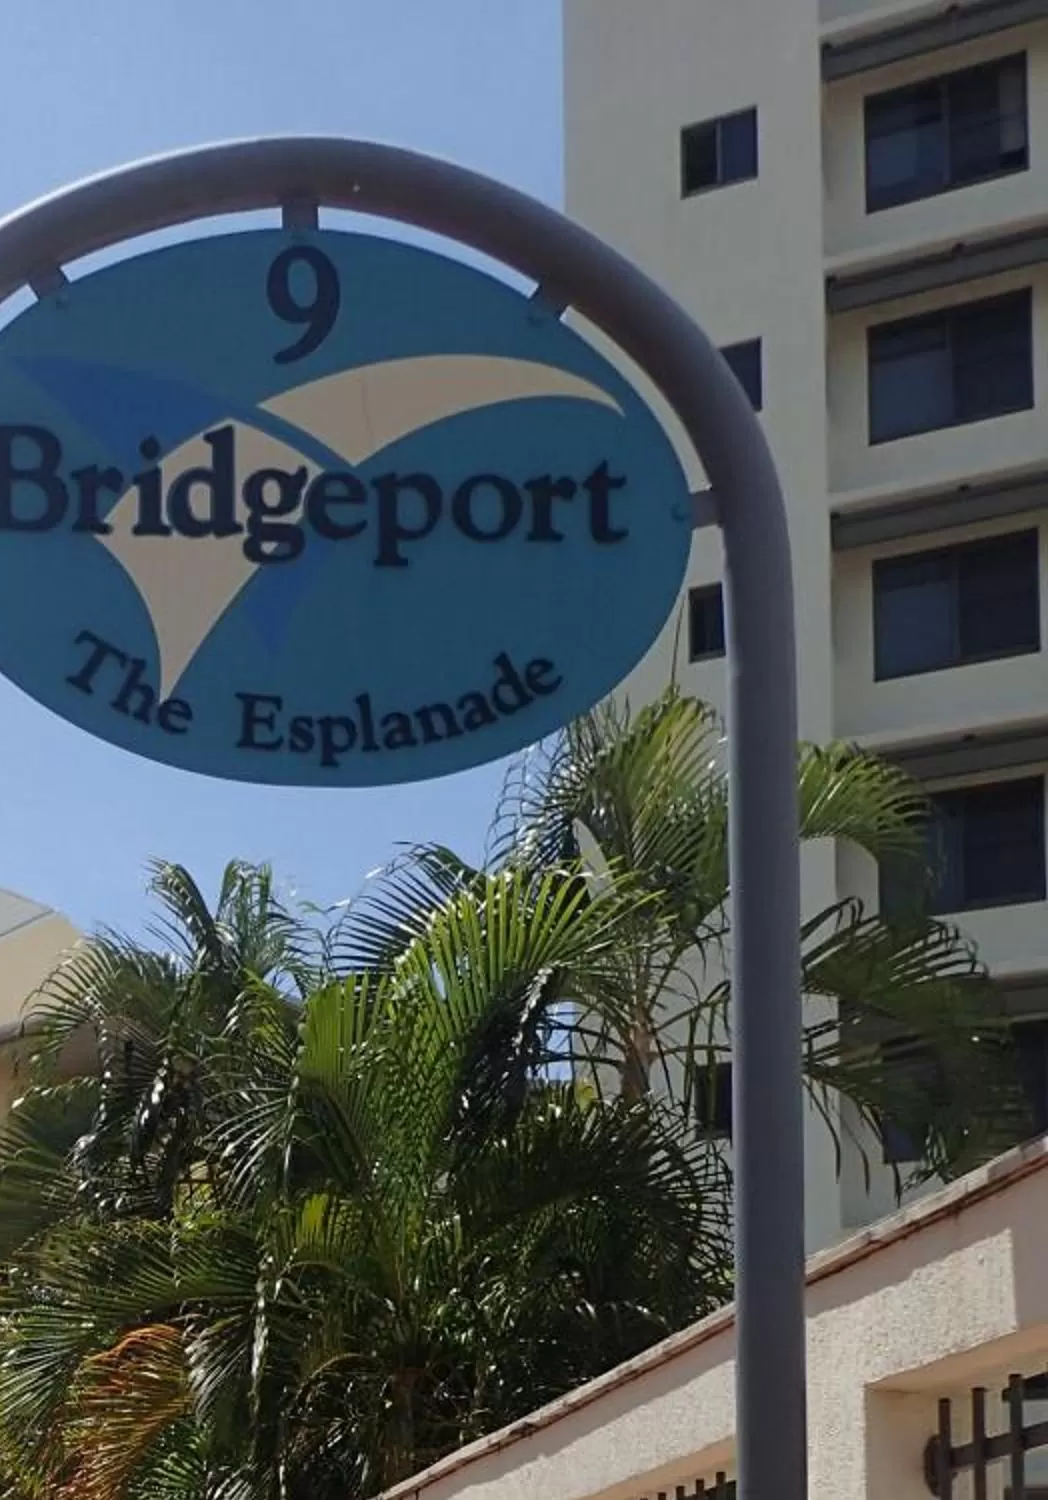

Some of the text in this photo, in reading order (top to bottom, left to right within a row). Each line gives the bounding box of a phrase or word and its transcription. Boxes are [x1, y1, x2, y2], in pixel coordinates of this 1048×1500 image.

[265, 246, 342, 364] 9
[65, 631, 564, 767] The Esplanade
